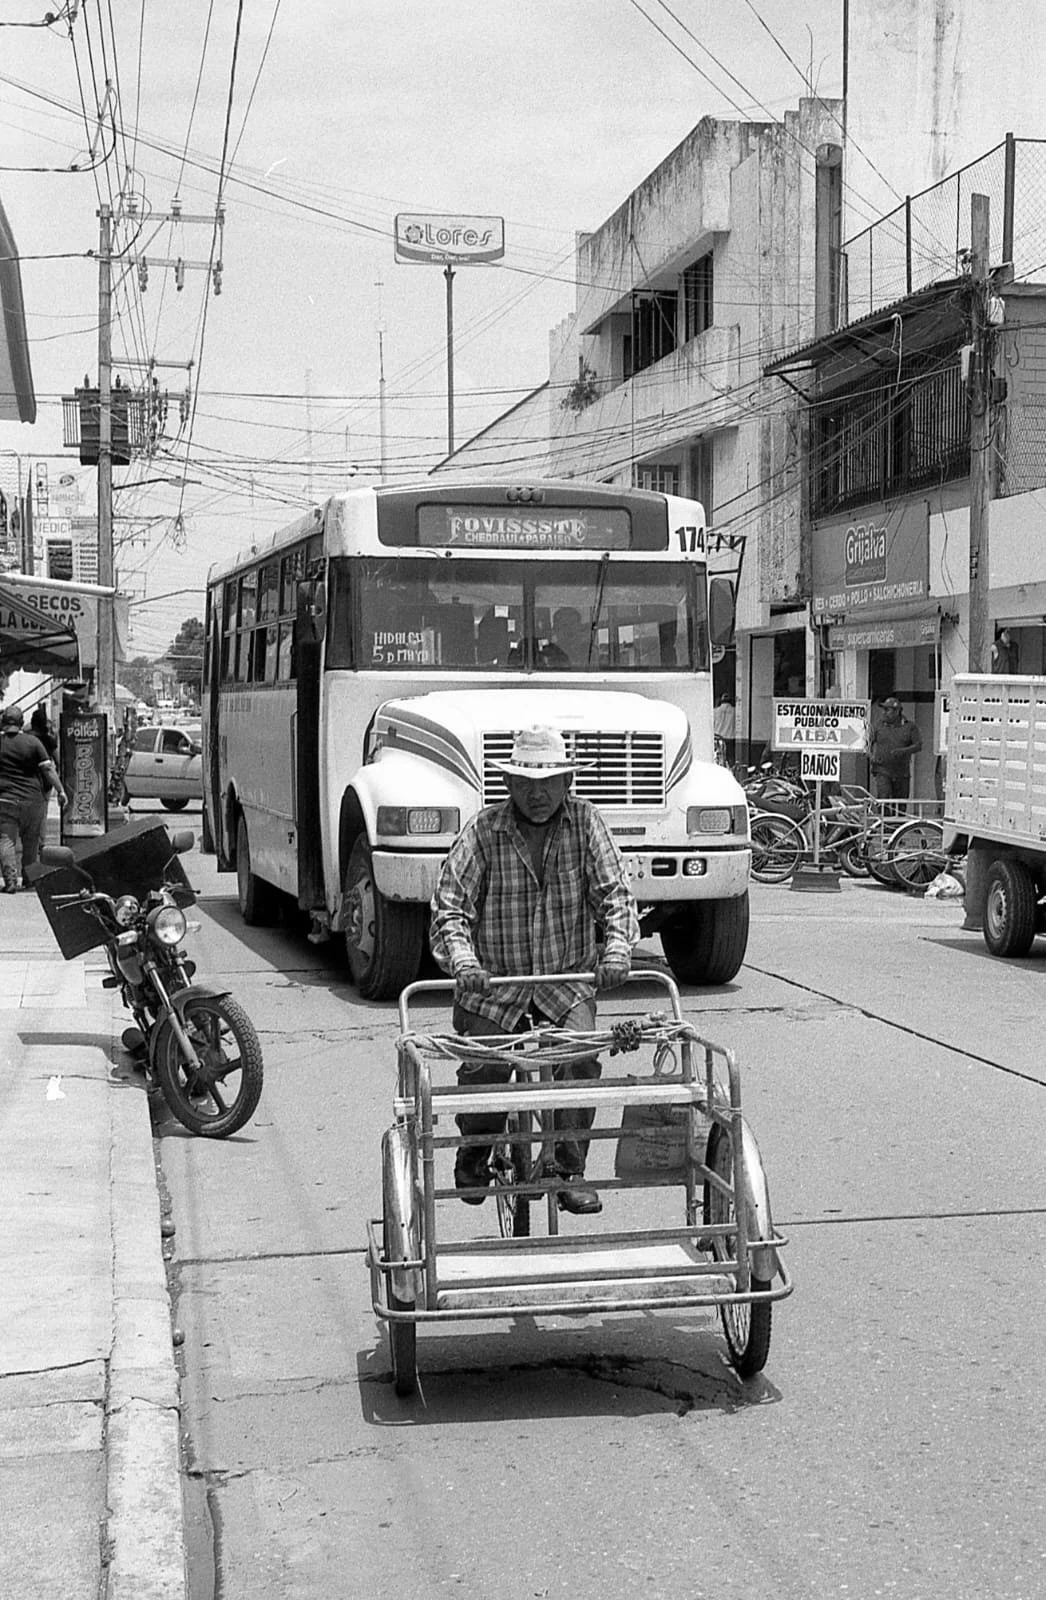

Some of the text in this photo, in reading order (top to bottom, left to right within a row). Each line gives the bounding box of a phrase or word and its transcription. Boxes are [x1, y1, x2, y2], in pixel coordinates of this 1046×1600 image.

[448, 516, 586, 543] FOVISSSTE
[675, 526, 705, 553] 174
[846, 529, 885, 565] Grijalva
[829, 593, 846, 608] CERDO
[851, 589, 868, 605] POLLO
[372, 646, 384, 663] 5
[777, 704, 865, 718] ESTACIONAMIENTO
[794, 717, 839, 728] PUBLICO
[793, 729, 838, 742] ALBA
[803, 753, 838, 776] BAÑOS
